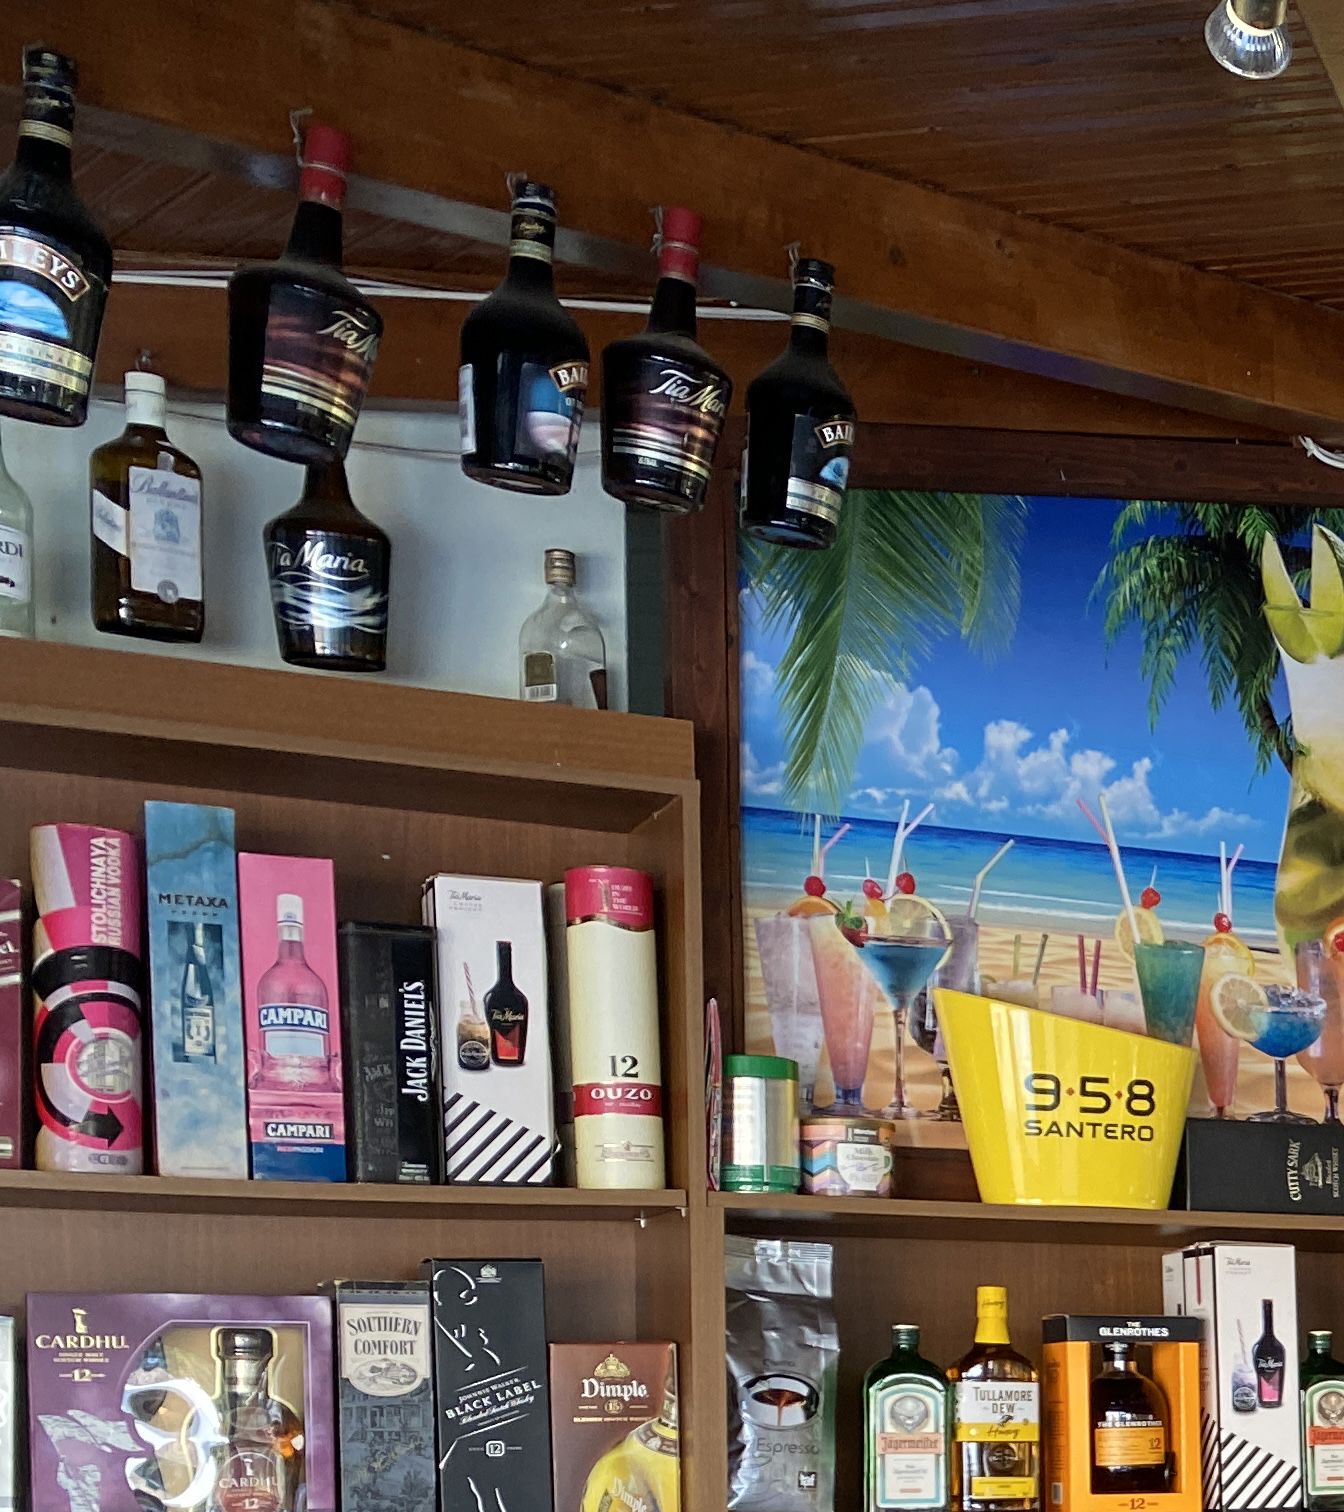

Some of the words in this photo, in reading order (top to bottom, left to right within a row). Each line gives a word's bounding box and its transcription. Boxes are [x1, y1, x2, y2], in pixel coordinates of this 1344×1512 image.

[648, 369, 695, 399] Tia
[294, 541, 370, 573] Maria
[106, 838, 122, 885] VODKA
[90, 836, 108, 945] STOLICHNAYA
[158, 892, 229, 909] METAXA
[105, 889, 122, 946] RUSSIAN
[260, 1007, 328, 1029] CAMPARI
[398, 979, 427, 1052] DANIEL'S
[608, 1055, 640, 1078] 12
[401, 1057, 429, 1102] JACK
[590, 1086, 653, 1101] OUZO
[266, 1123, 331, 1139] CAMPARI
[1024, 1121, 1156, 1142] SANTERO
[1288, 1138, 1302, 1167] SARK
[1286, 1167, 1302, 1202] CUTTY
[346, 1316, 423, 1338] SOUTHERN
[1099, 1327, 1170, 1338] GLENROTHES
[35, 1333, 130, 1350] CARDHU
[353, 1339, 417, 1356] COMFORT
[72, 1368, 92, 1382] 12
[445, 1396, 493, 1419] BLACK
[496, 1380, 543, 1402] LABEL
[581, 1378, 649, 1402] Dimple
[972, 1386, 1033, 1401] TULLAMORE
[992, 1403, 1016, 1414] DEW
[490, 1443, 501, 1454] 12
[756, 1437, 820, 1457] Espresso
[242, 1498, 260, 1510] 12
[1129, 1497, 1147, 1510] 12
